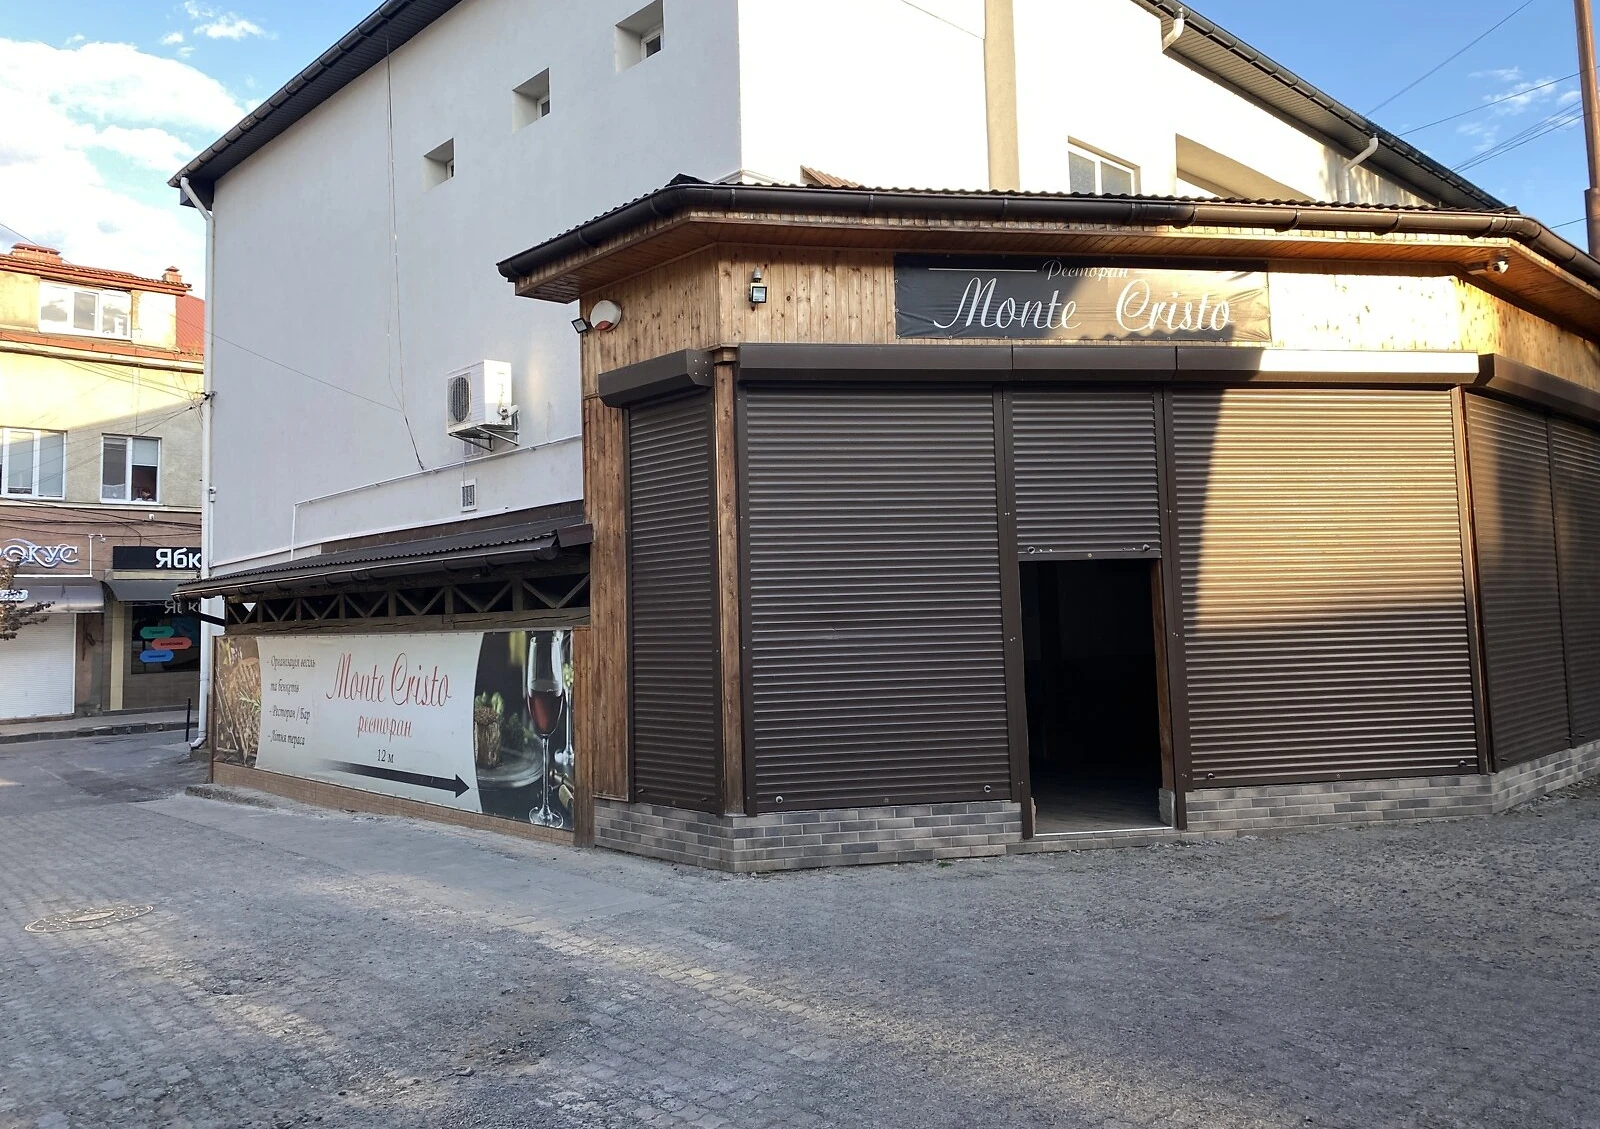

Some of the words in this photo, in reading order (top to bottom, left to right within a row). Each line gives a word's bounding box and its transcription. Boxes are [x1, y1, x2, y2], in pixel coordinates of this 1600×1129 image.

[1041, 259, 1128, 281] Ресторан
[933, 276, 1082, 329] Monte
[1115, 279, 1235, 332] Cristo
[325, 652, 389, 702] Monte
[390, 652, 452, 706] Cristo
[300, 707, 311, 724] Бар
[357, 715, 412, 742] ресторан
[287, 734, 305, 749] тераса
[377, 748, 387, 762] 12
